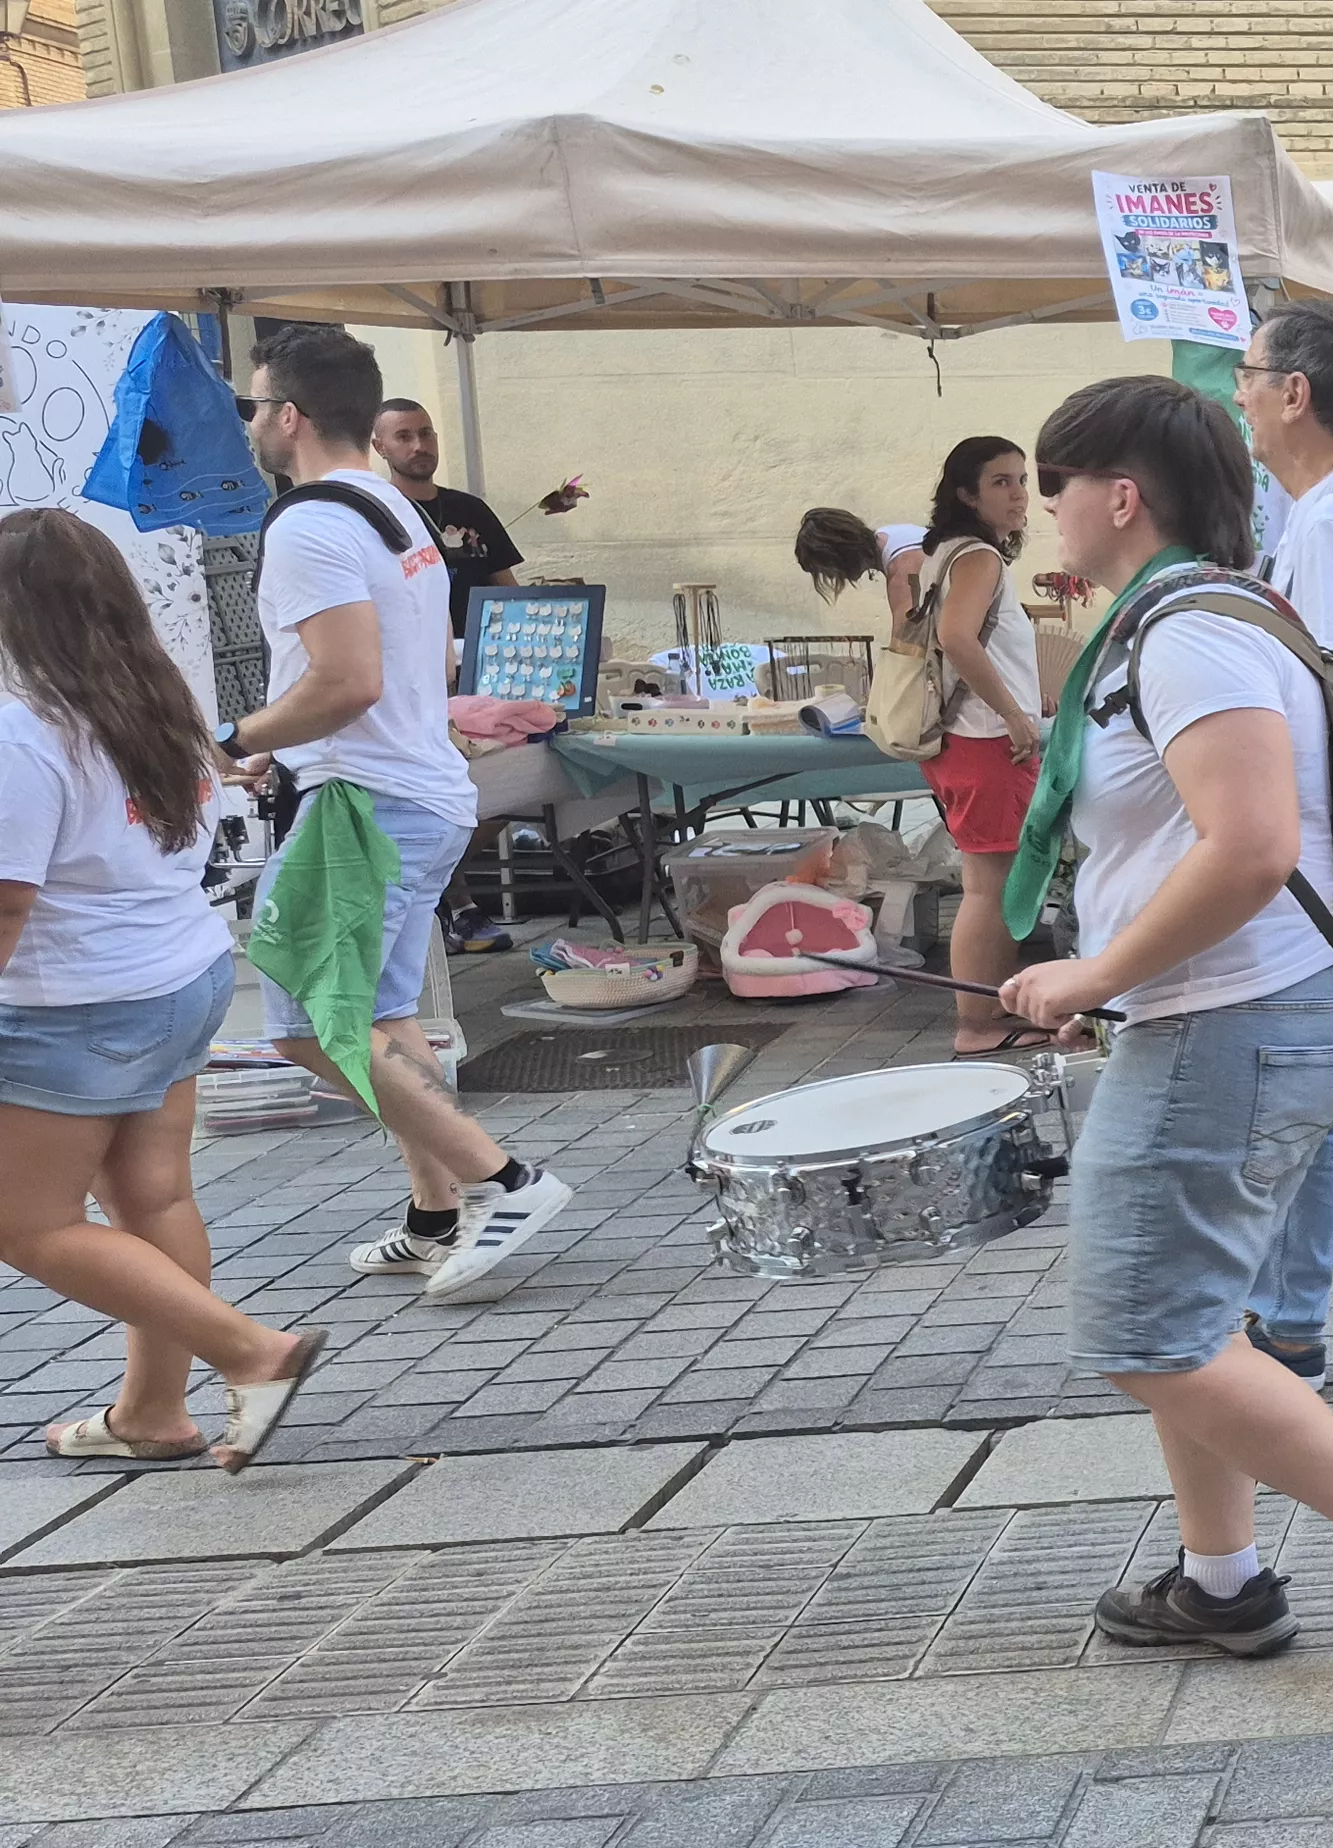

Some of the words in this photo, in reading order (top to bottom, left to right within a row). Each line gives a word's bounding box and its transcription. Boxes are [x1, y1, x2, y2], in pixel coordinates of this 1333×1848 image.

[1129, 183, 1168, 193] VENTA
[1171, 182, 1187, 192] DE
[1115, 192, 1214, 214] IMANES
[1129, 216, 1211, 229] SOLIDARIOS
[708, 674, 745, 690] RAZA
